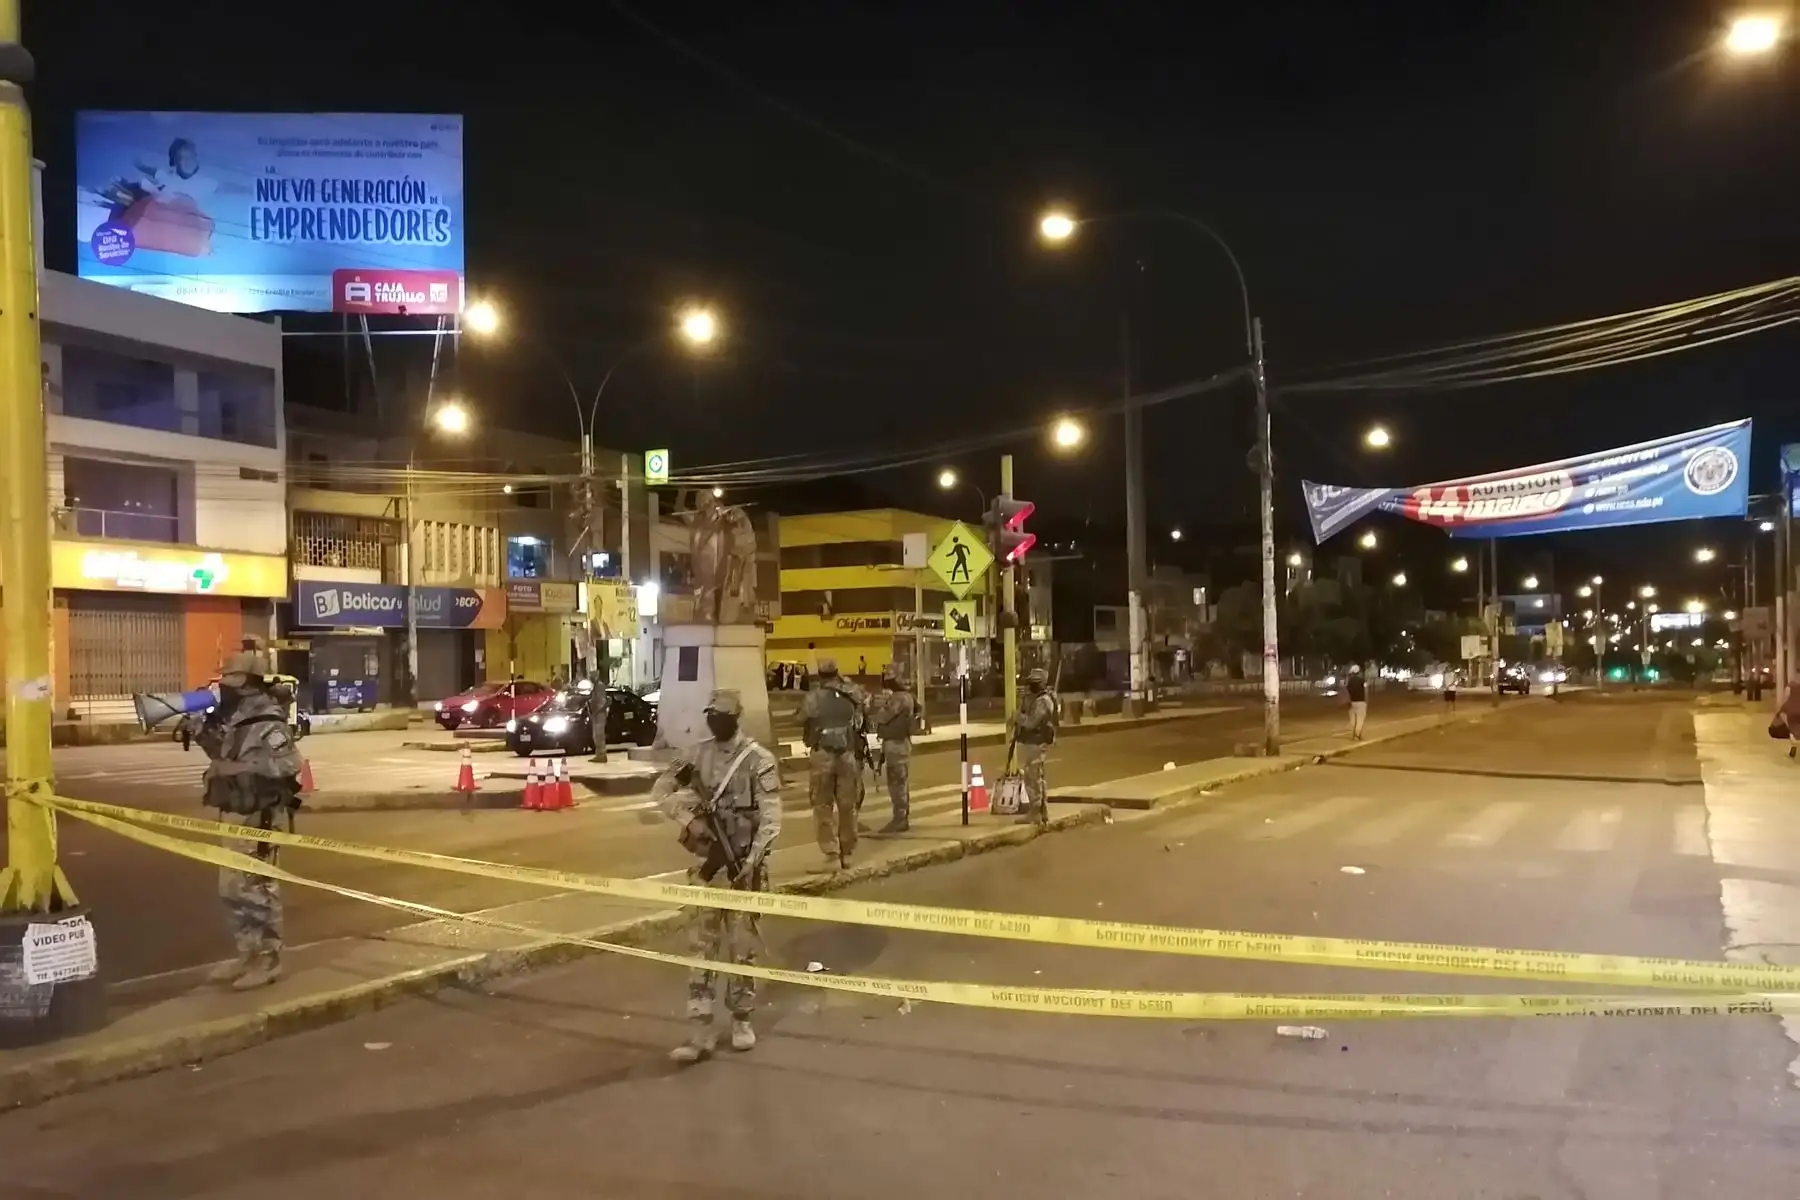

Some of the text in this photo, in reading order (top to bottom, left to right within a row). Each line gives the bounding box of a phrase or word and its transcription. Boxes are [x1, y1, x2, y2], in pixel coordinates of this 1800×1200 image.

[256, 178, 316, 202] NUEVA
[321, 175, 426, 205] GENERACIÓN
[250, 206, 451, 242] EMPRENDEDORES
[374, 281, 404, 292] CAJA
[374, 292, 426, 303] TRUJILLO
[1412, 484, 1465, 522] 14
[1466, 491, 1562, 517] marzo
[342, 591, 396, 610] Boticas
[411, 595, 441, 611] alud
[459, 596, 476, 608] BCP
[240, 827, 273, 839] CRUZAR
[32, 933, 66, 947] VIDEO
